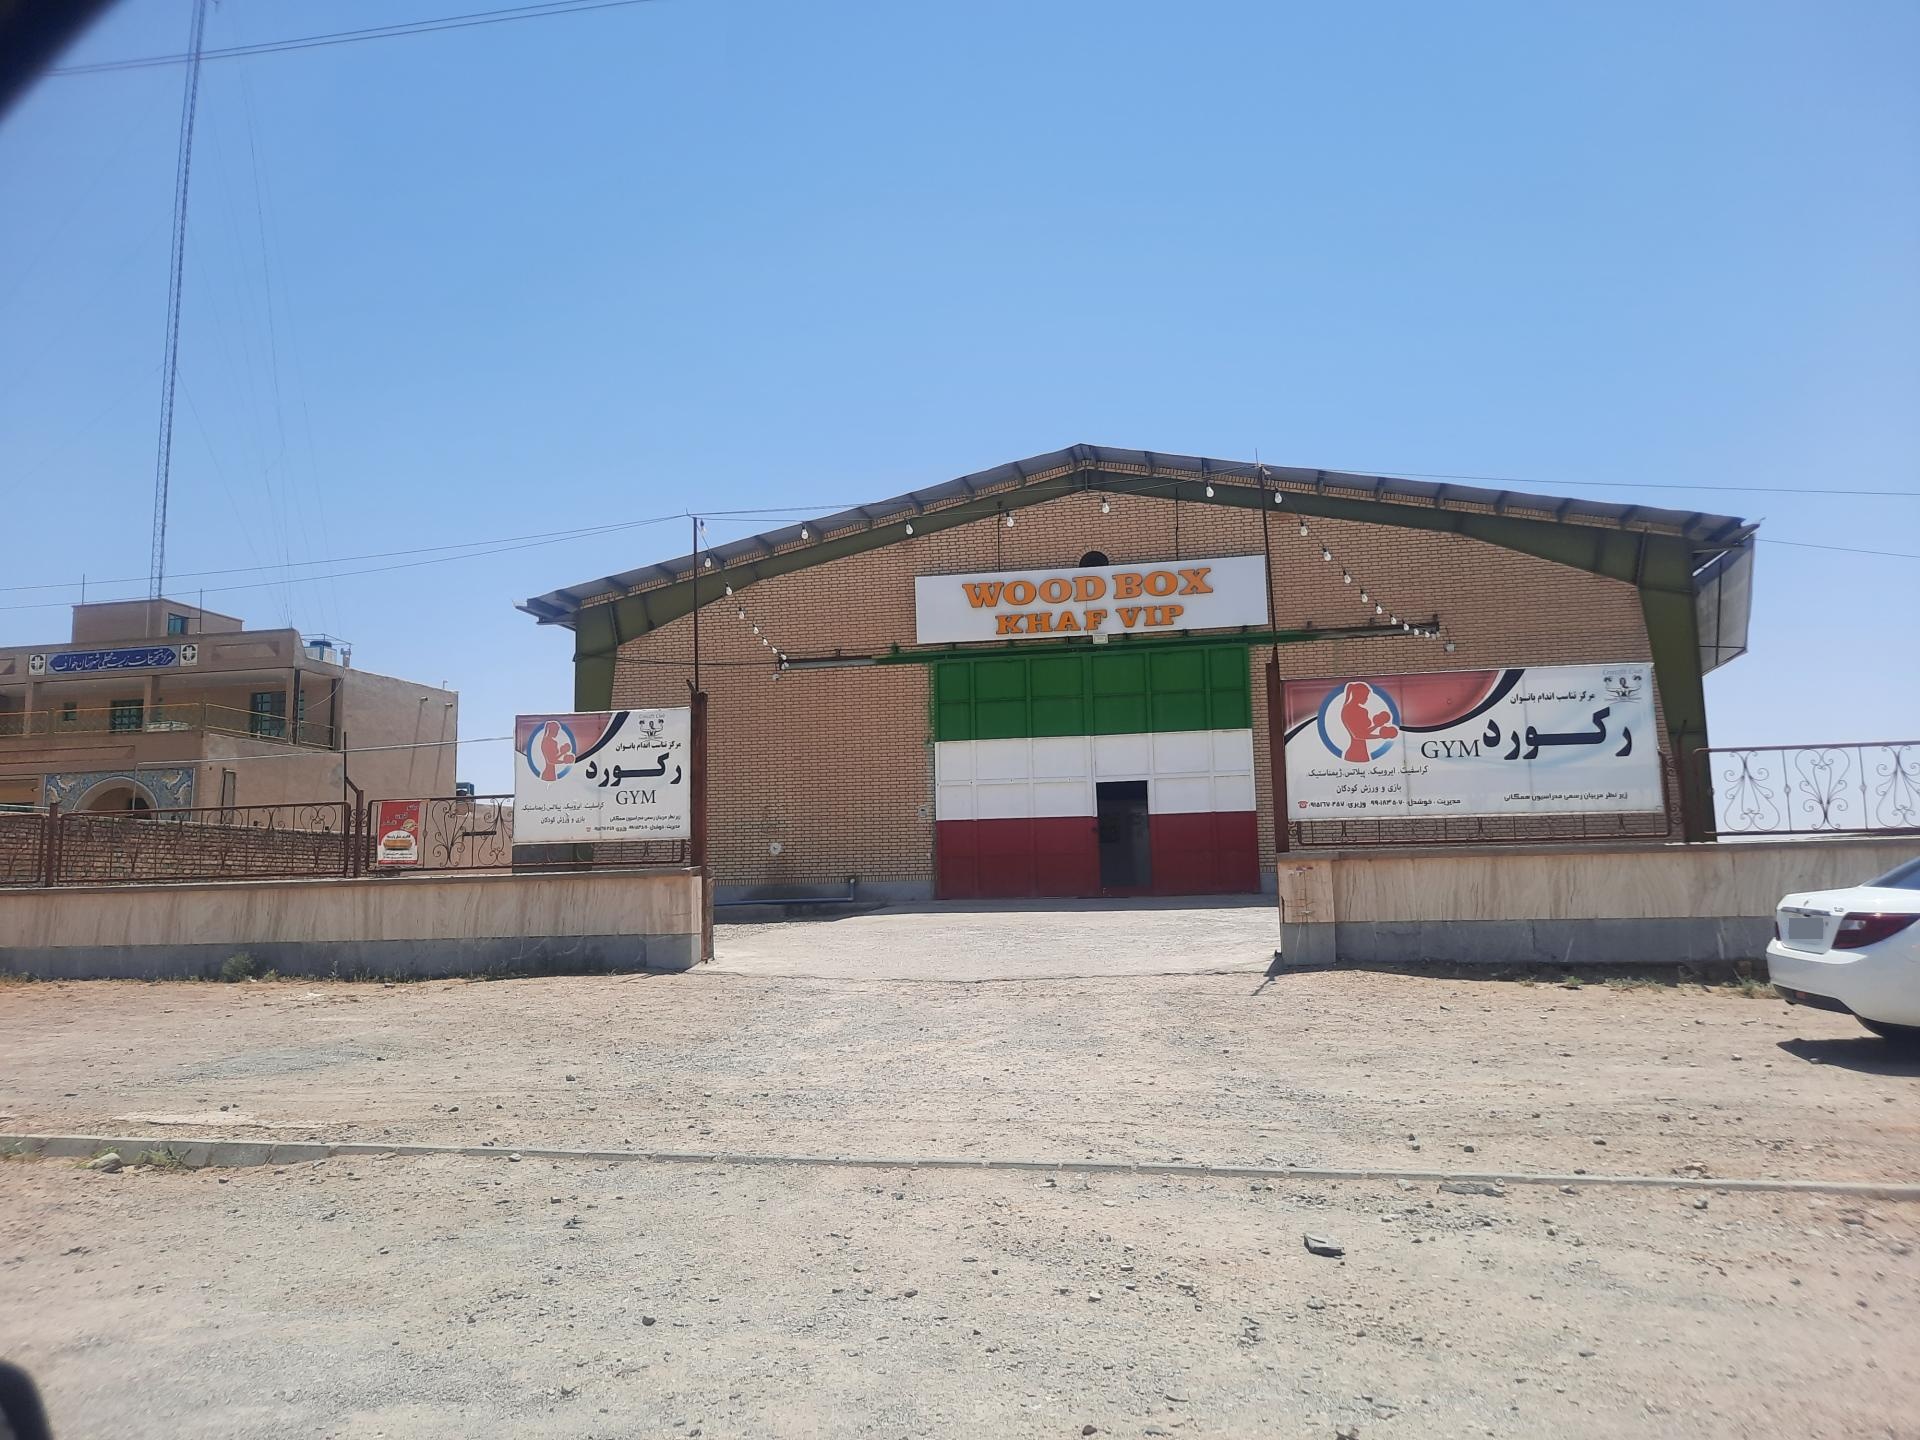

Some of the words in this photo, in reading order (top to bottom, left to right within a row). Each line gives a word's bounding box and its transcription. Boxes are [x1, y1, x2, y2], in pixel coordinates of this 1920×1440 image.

[962, 575, 1106, 609] WOOD
[1113, 568, 1214, 600] BOX
[995, 609, 1108, 635] KHAF
[1115, 604, 1185, 628] VIP
[54, 655, 77, 671] خواف
[1509, 693, 1536, 705] بانوان
[1537, 692, 1555, 704] اندام
[1556, 691, 1578, 701] تناسب
[1579, 690, 1596, 701] مرکز
[1483, 706, 1633, 760] رکورد
[615, 742, 636, 752] بانوان
[636, 741, 650, 751] اندام
[651, 741, 667, 749] تناسب
[668, 740, 682, 750] مرکز
[1421, 739, 1481, 759] GYM
[585, 752, 682, 787] رکورد
[1336, 784, 1358, 794] کودکان
[1360, 784, 1379, 794] ورزش
[1388, 783, 1402, 793] بازی
[615, 789, 657, 805] GYM
